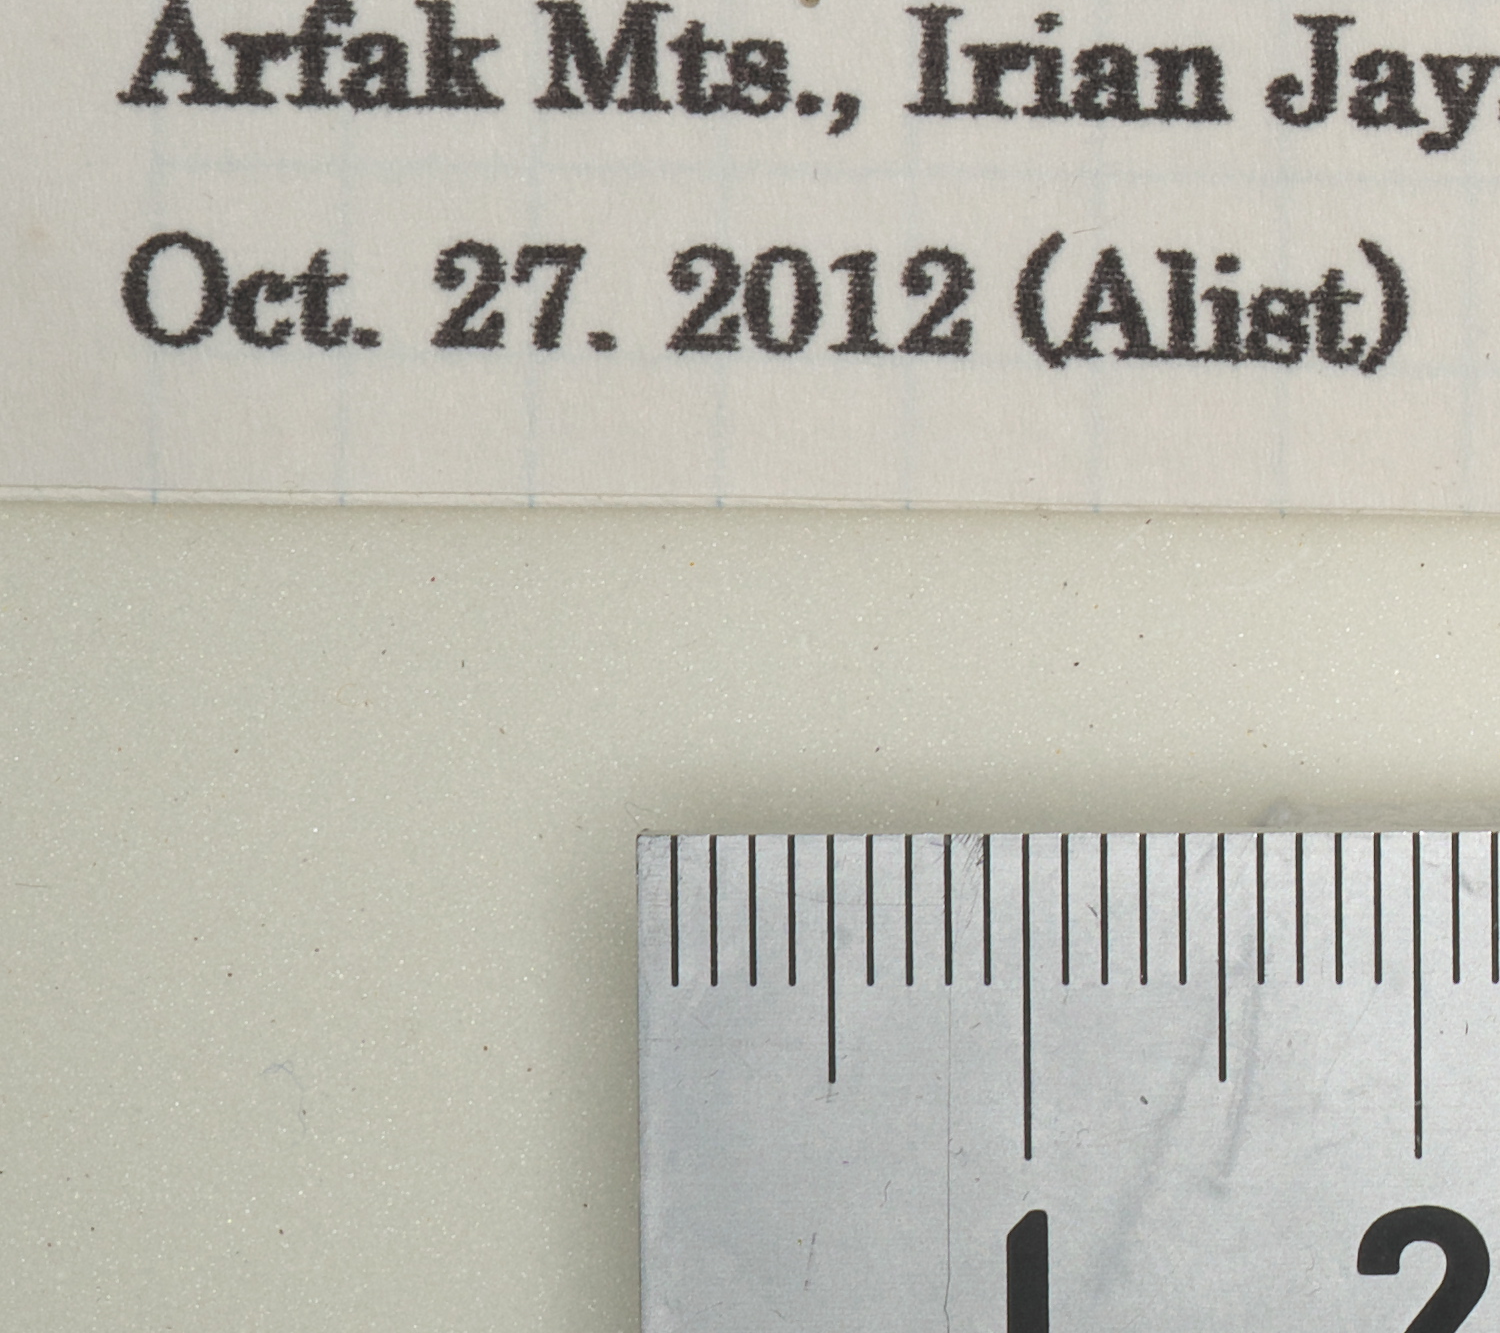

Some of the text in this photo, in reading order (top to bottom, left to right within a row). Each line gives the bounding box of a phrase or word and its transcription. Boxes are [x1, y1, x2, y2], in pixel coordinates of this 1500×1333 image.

[534, 0, 860, 136] Mts.,
[904, 3, 1232, 122] Irian
[121, 231, 1409, 374] Oct. 27. 2012 (Alist)
